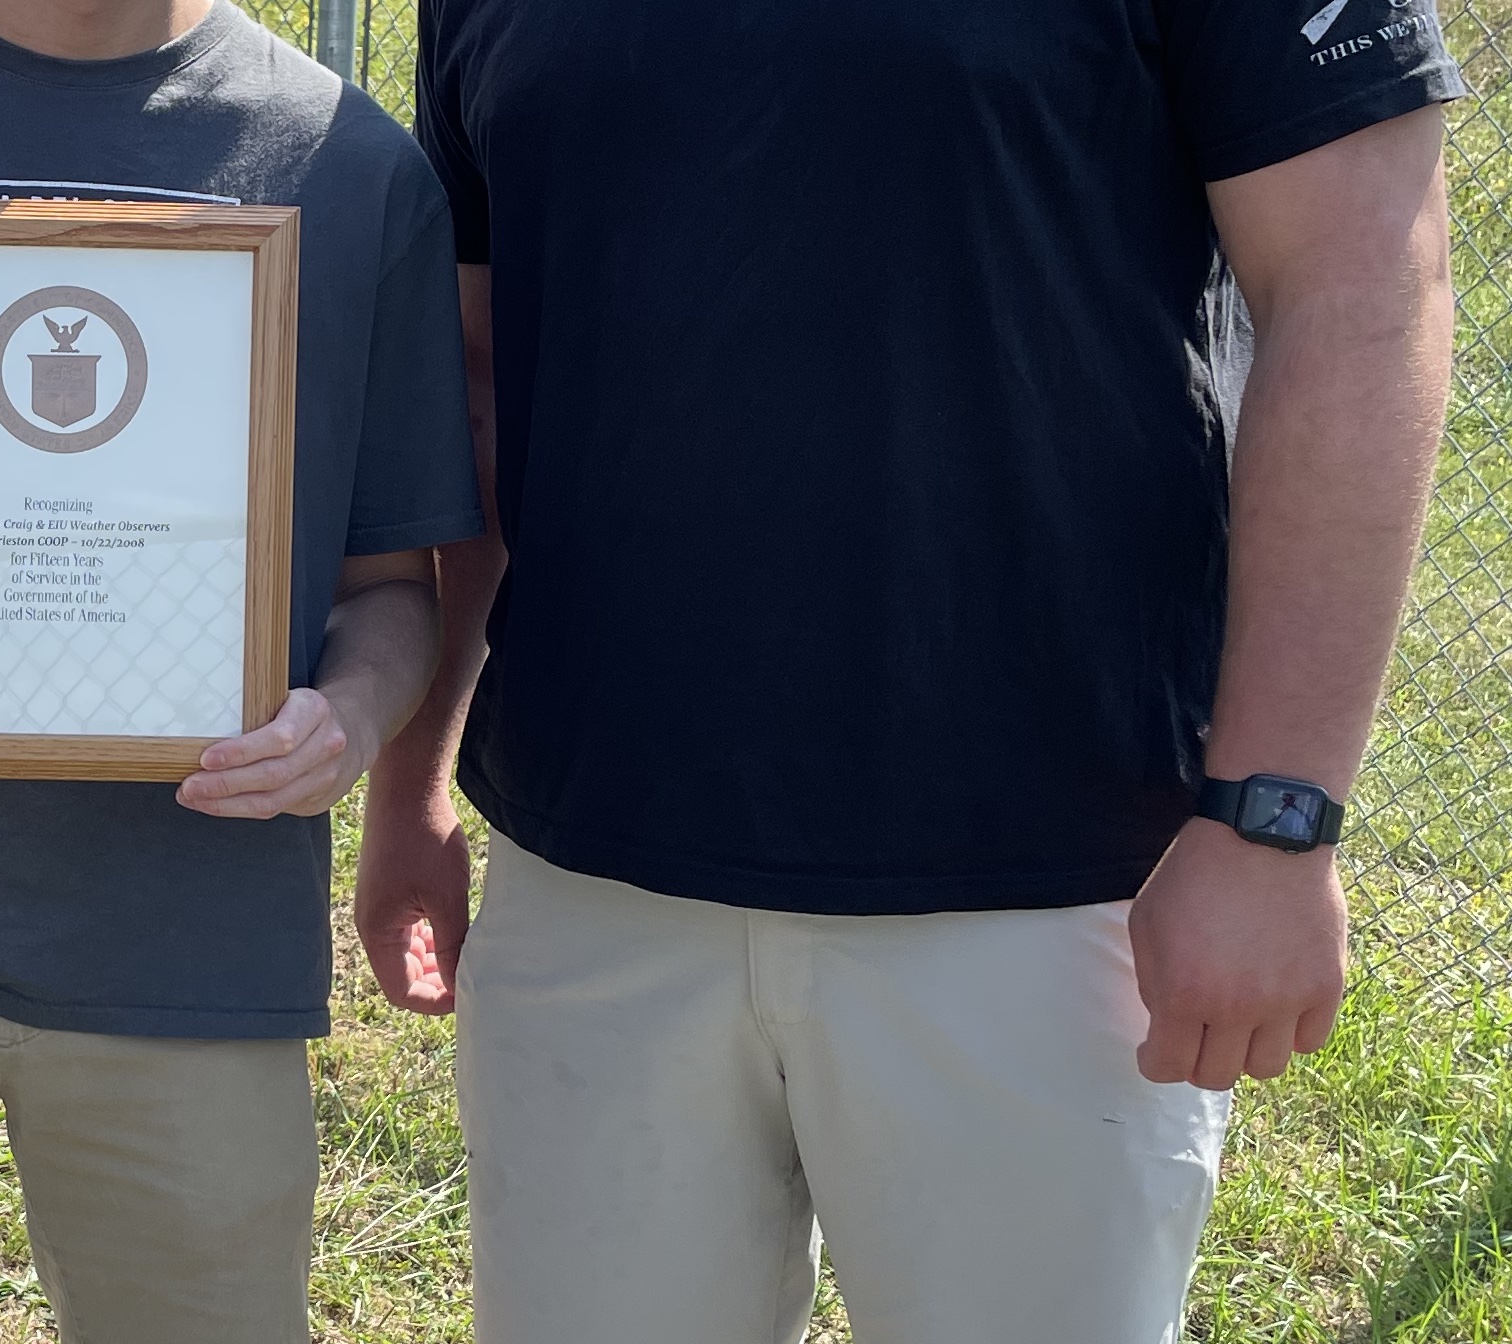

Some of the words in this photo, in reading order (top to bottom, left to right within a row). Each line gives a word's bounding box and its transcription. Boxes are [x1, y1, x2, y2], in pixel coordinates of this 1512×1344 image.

[1310, 35, 1373, 66] THIS
[24, 497, 93, 515] Recognizing
[3, 519, 33, 532] Craig
[35, 519, 45, 530] &
[48, 520, 68, 530] EIU
[70, 520, 115, 531] Weather
[118, 520, 170, 532] Observers
[37, 536, 68, 547] COOP
[80, 537, 145, 549] 10/22/2008
[10, 551, 27, 566] for
[30, 551, 70, 567] Fifteen
[73, 553, 104, 568] Years
[11, 570, 24, 584] of
[26, 570, 67, 585] Service
[70, 571, 81, 585] in
[83, 571, 102, 586] the
[3, 587, 73, 604] Government
[75, 590, 88, 604] of
[90, 590, 109, 605] the
[25, 606, 62, 622] States
[63, 607, 76, 622] of
[78, 608, 126, 623] America
